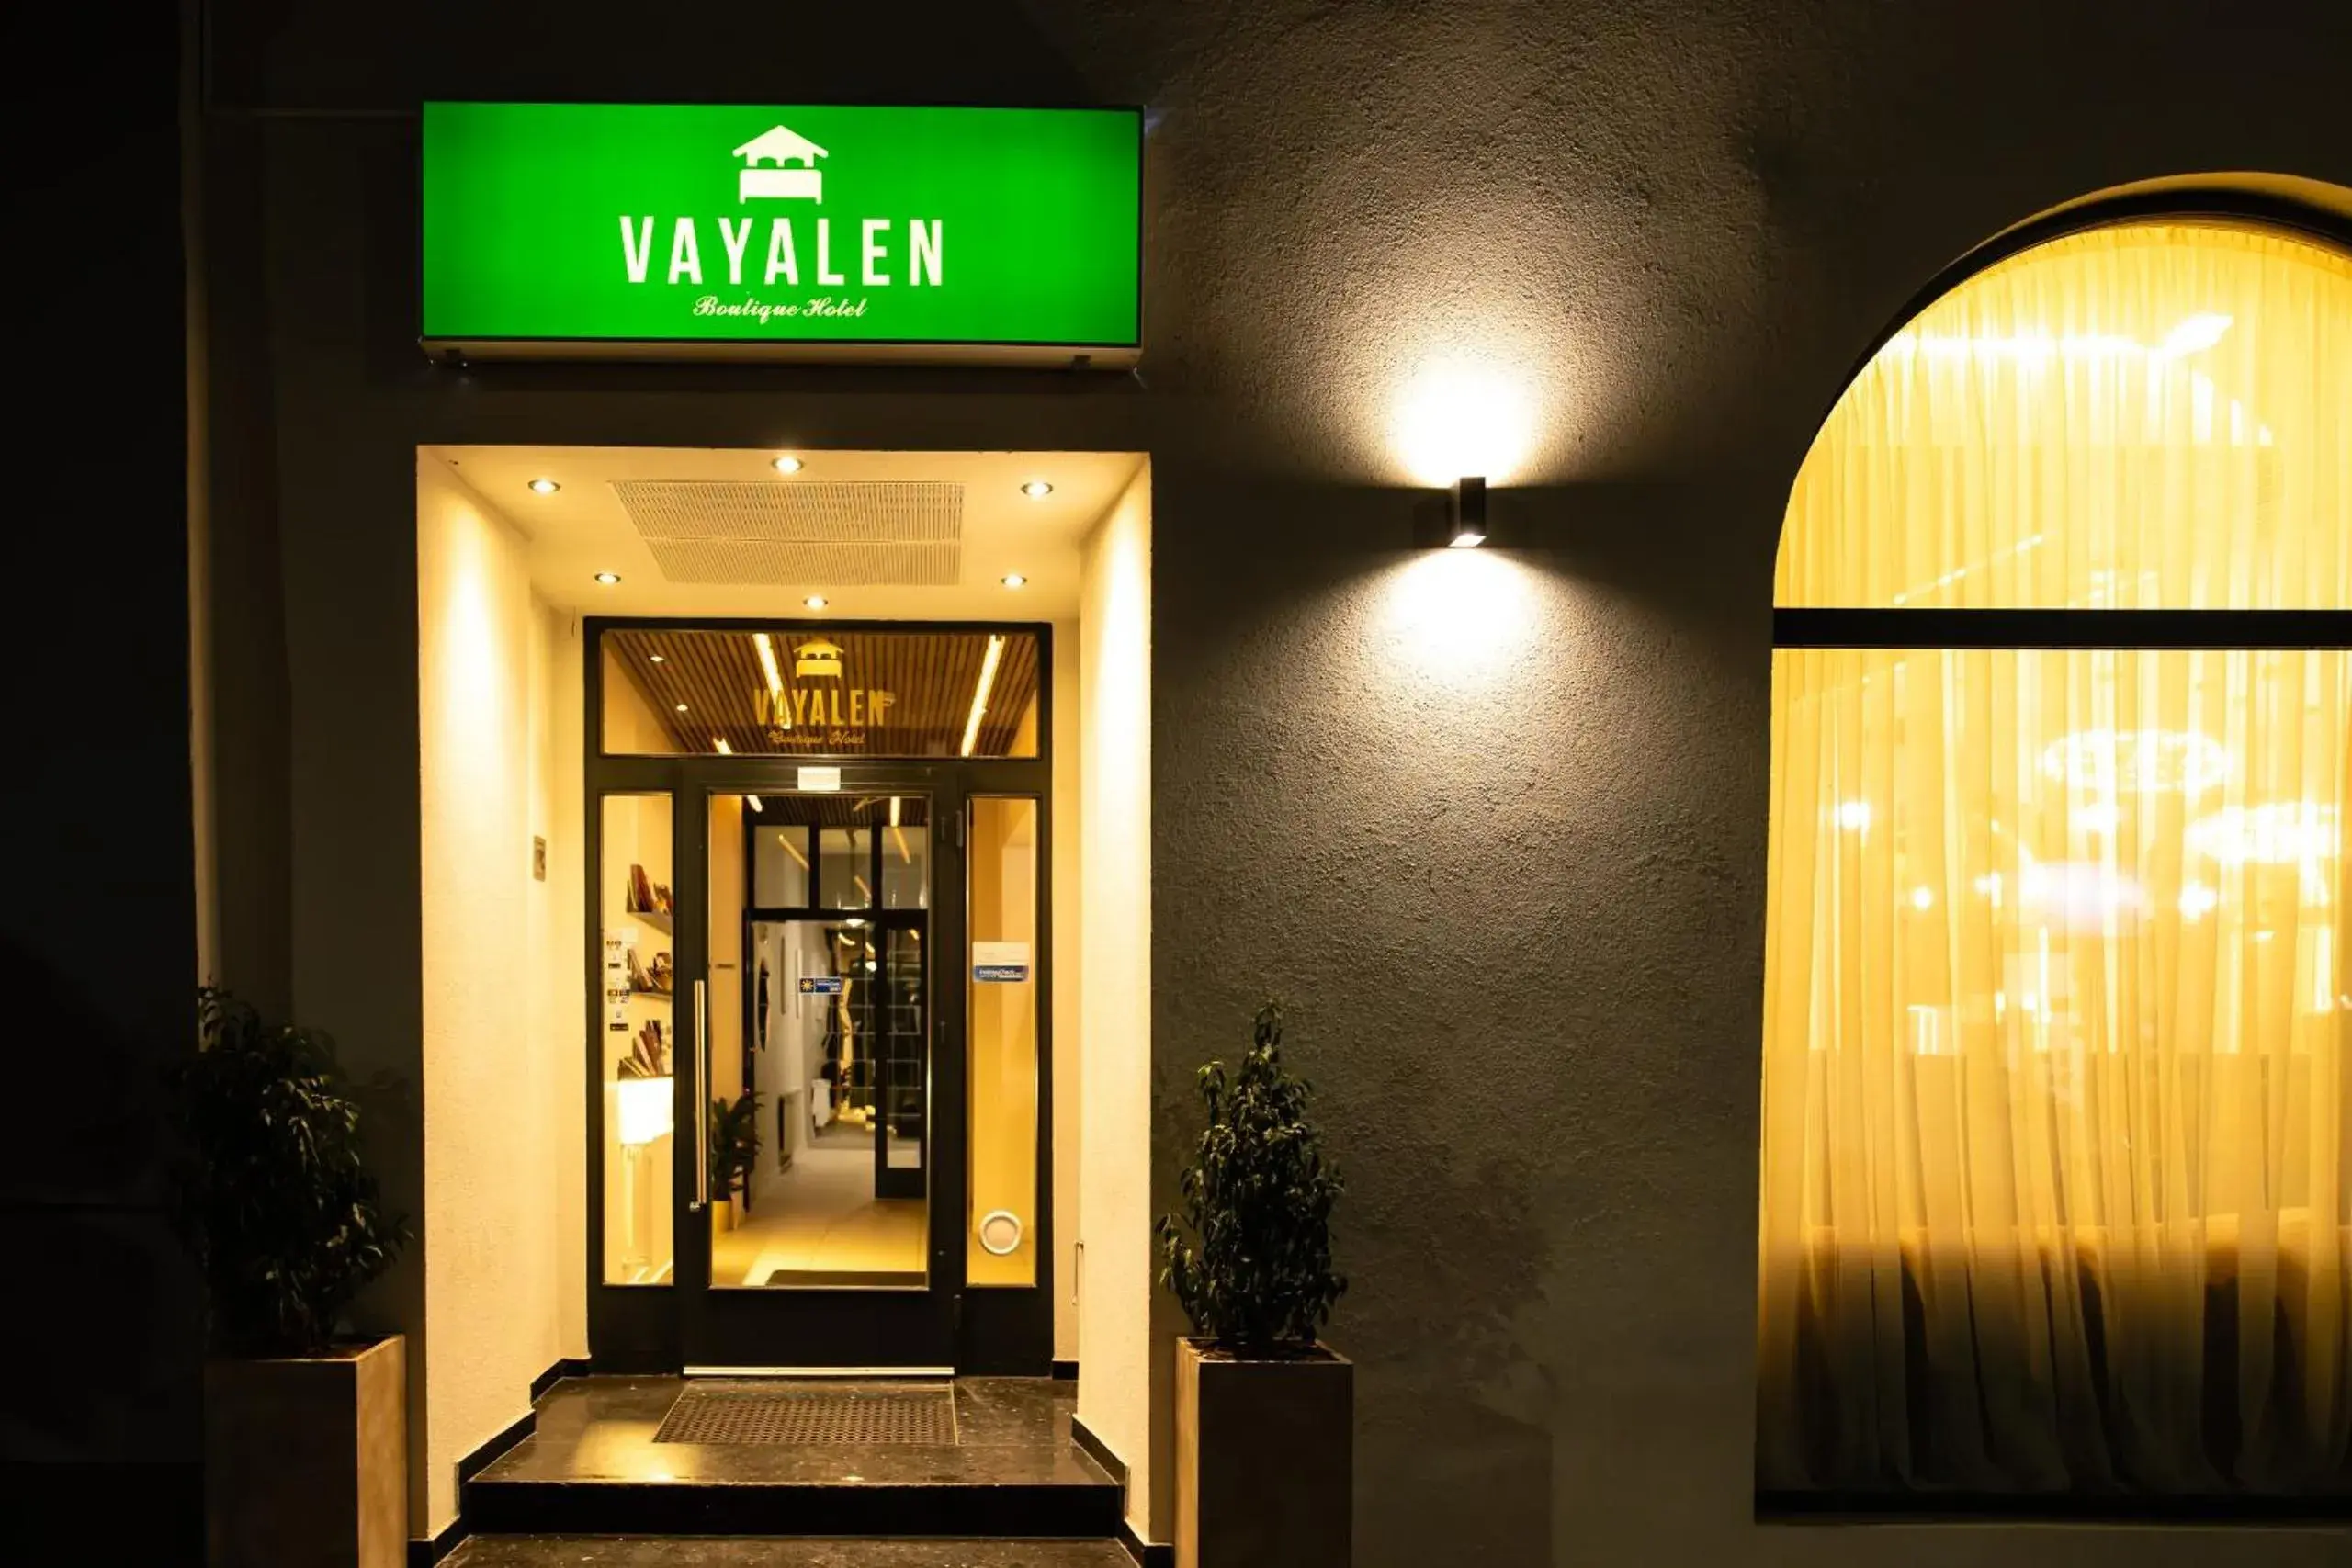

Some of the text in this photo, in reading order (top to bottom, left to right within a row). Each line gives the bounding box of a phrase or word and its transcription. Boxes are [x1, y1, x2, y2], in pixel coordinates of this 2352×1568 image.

[620, 216, 943, 287] VAYALEN
[693, 295, 868, 324] Boutique Hotel
[753, 689, 885, 727] VAYALEN
[829, 729, 866, 745] Hotel
